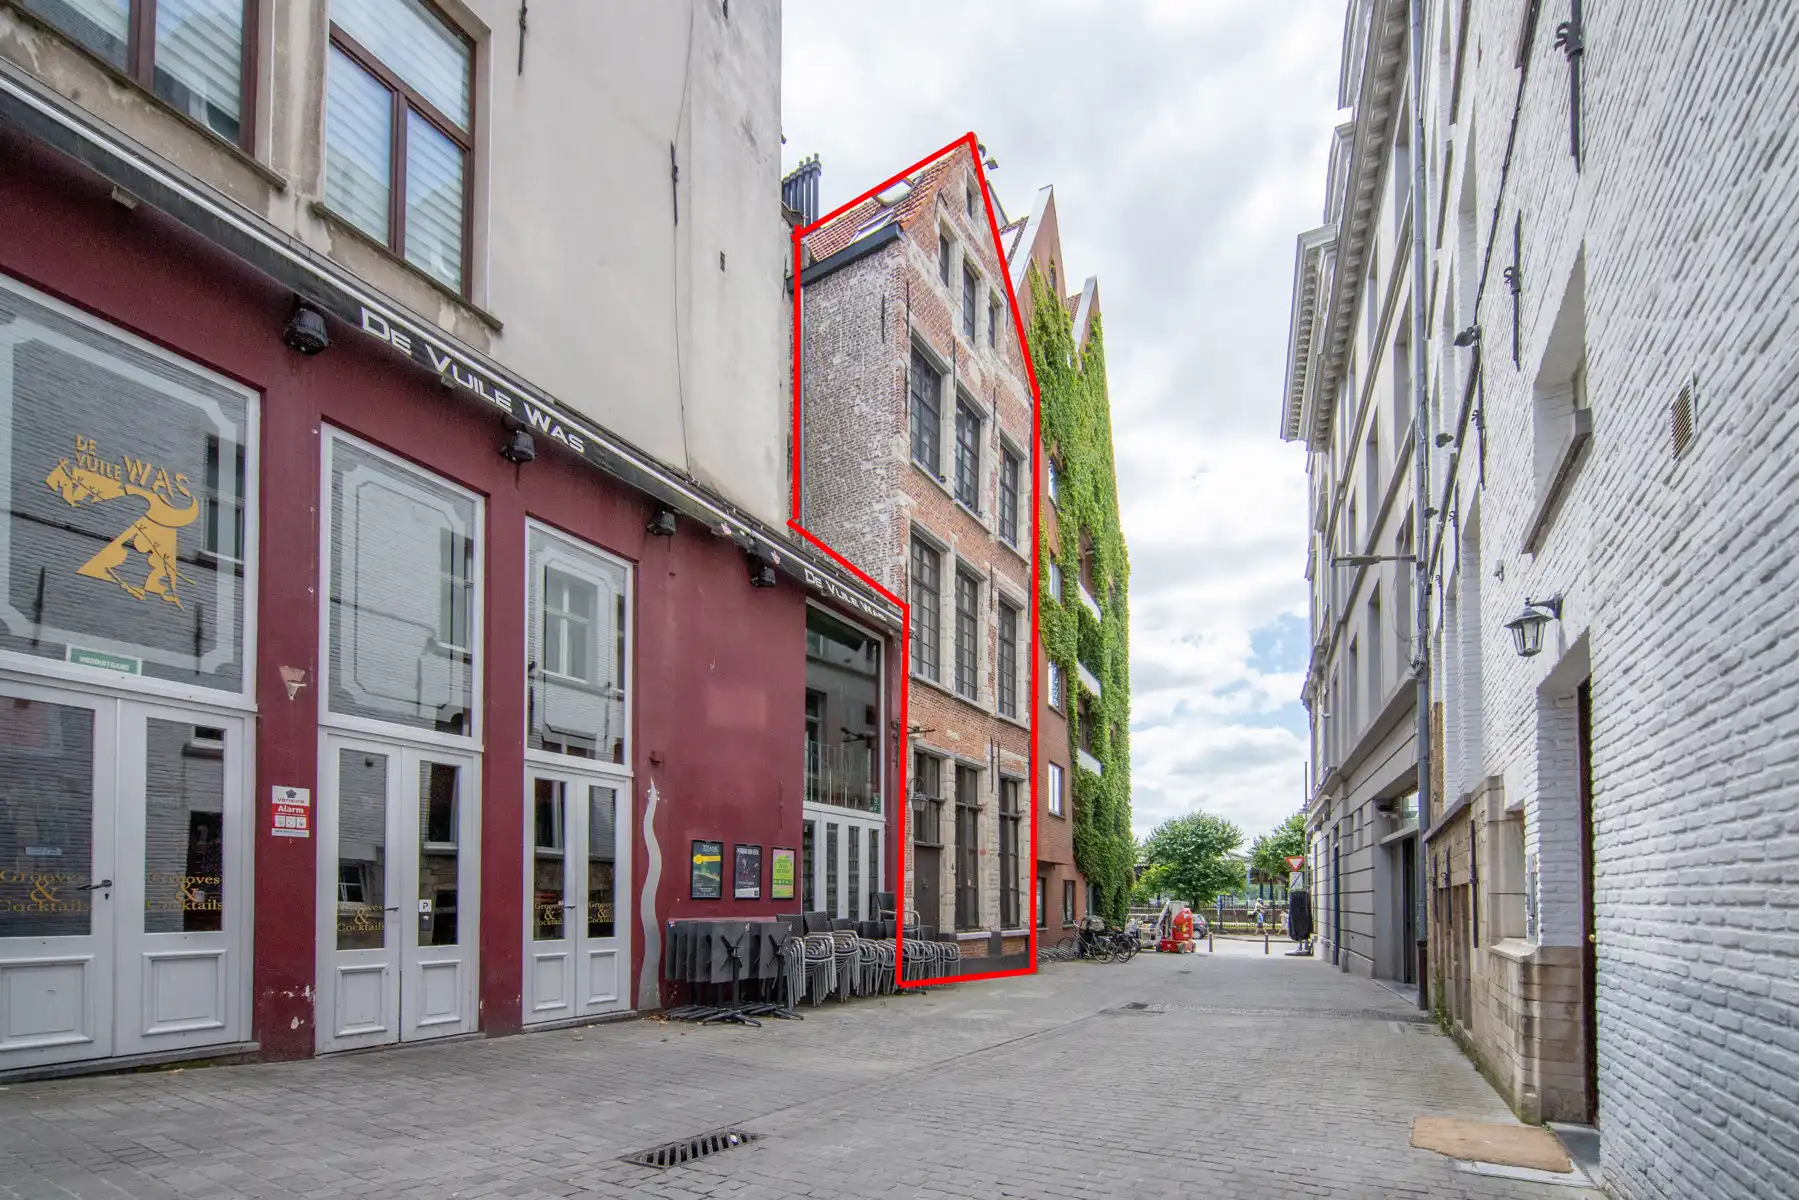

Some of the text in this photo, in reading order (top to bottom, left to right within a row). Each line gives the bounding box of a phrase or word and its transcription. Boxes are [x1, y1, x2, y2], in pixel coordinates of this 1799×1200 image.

[425, 343, 513, 414] VUILE
[523, 401, 585, 454] WAS
[75, 435, 97, 456] DE
[121, 454, 192, 498] WAS
[277, 804, 304, 814] Alarm
[28, 876, 62, 904] &
